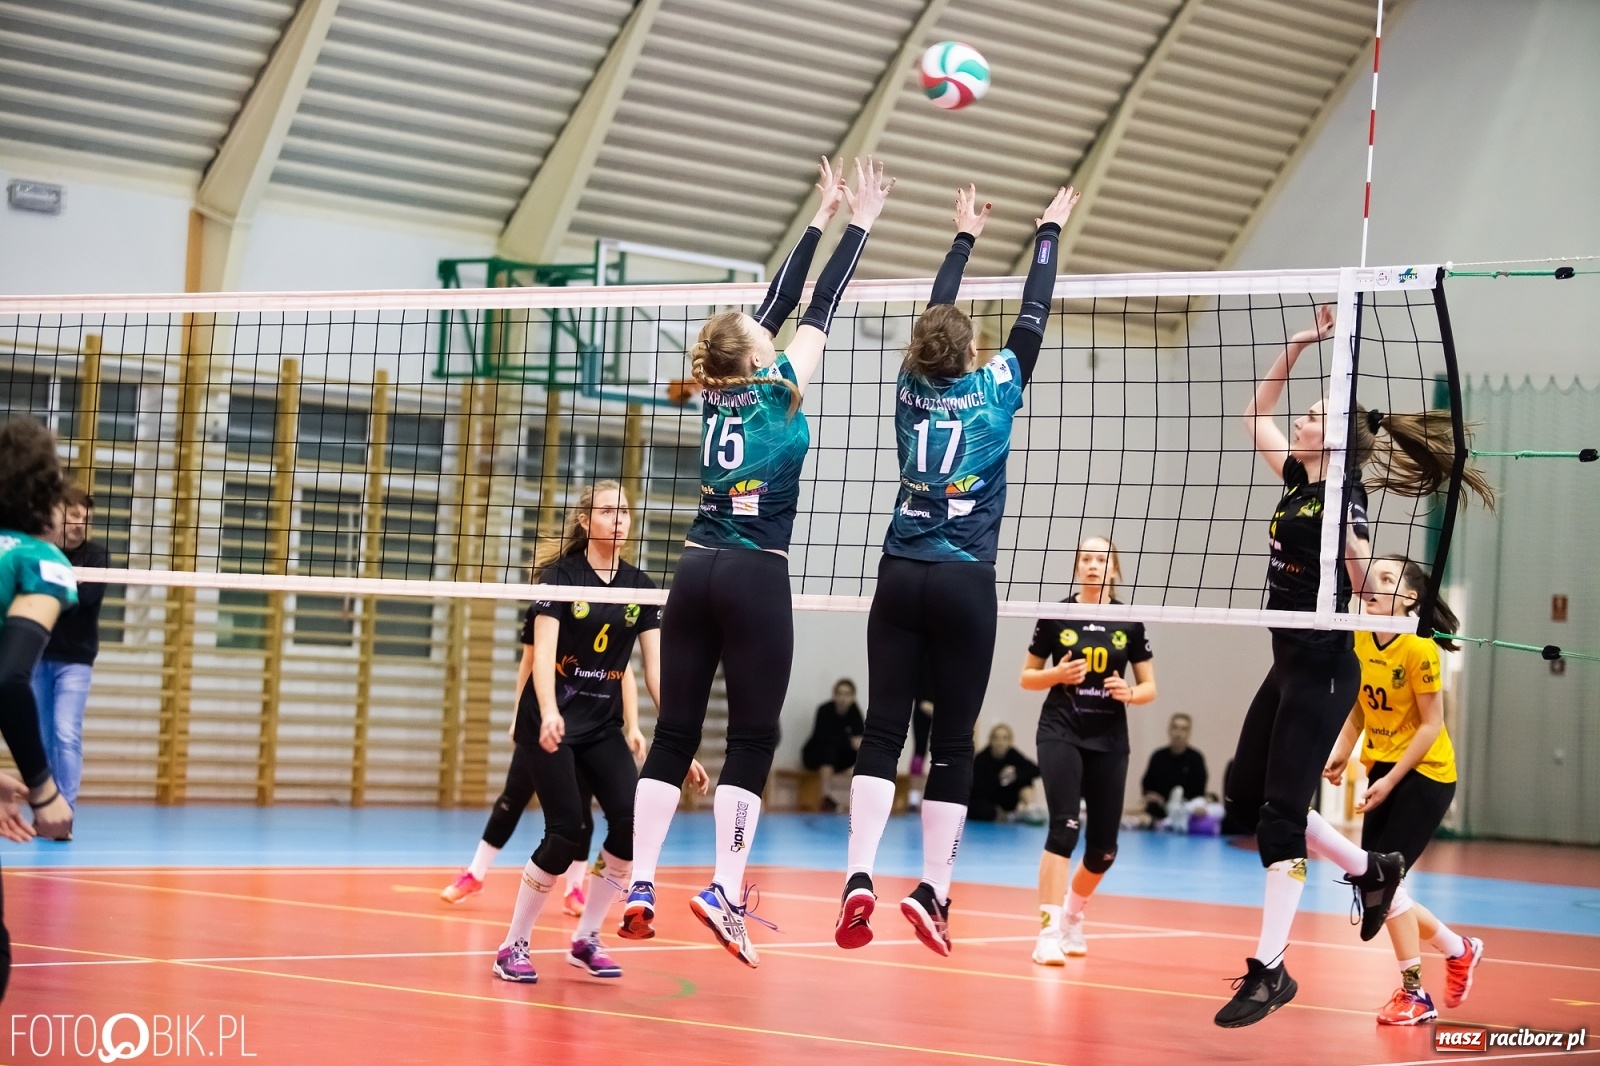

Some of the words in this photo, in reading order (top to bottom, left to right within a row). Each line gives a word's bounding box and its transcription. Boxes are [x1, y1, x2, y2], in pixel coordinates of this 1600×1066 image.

[703, 413, 744, 470] 15
[913, 418, 963, 474] 17
[593, 623, 611, 653] 6
[1082, 646, 1108, 673] 10
[1363, 684, 1393, 711] 32
